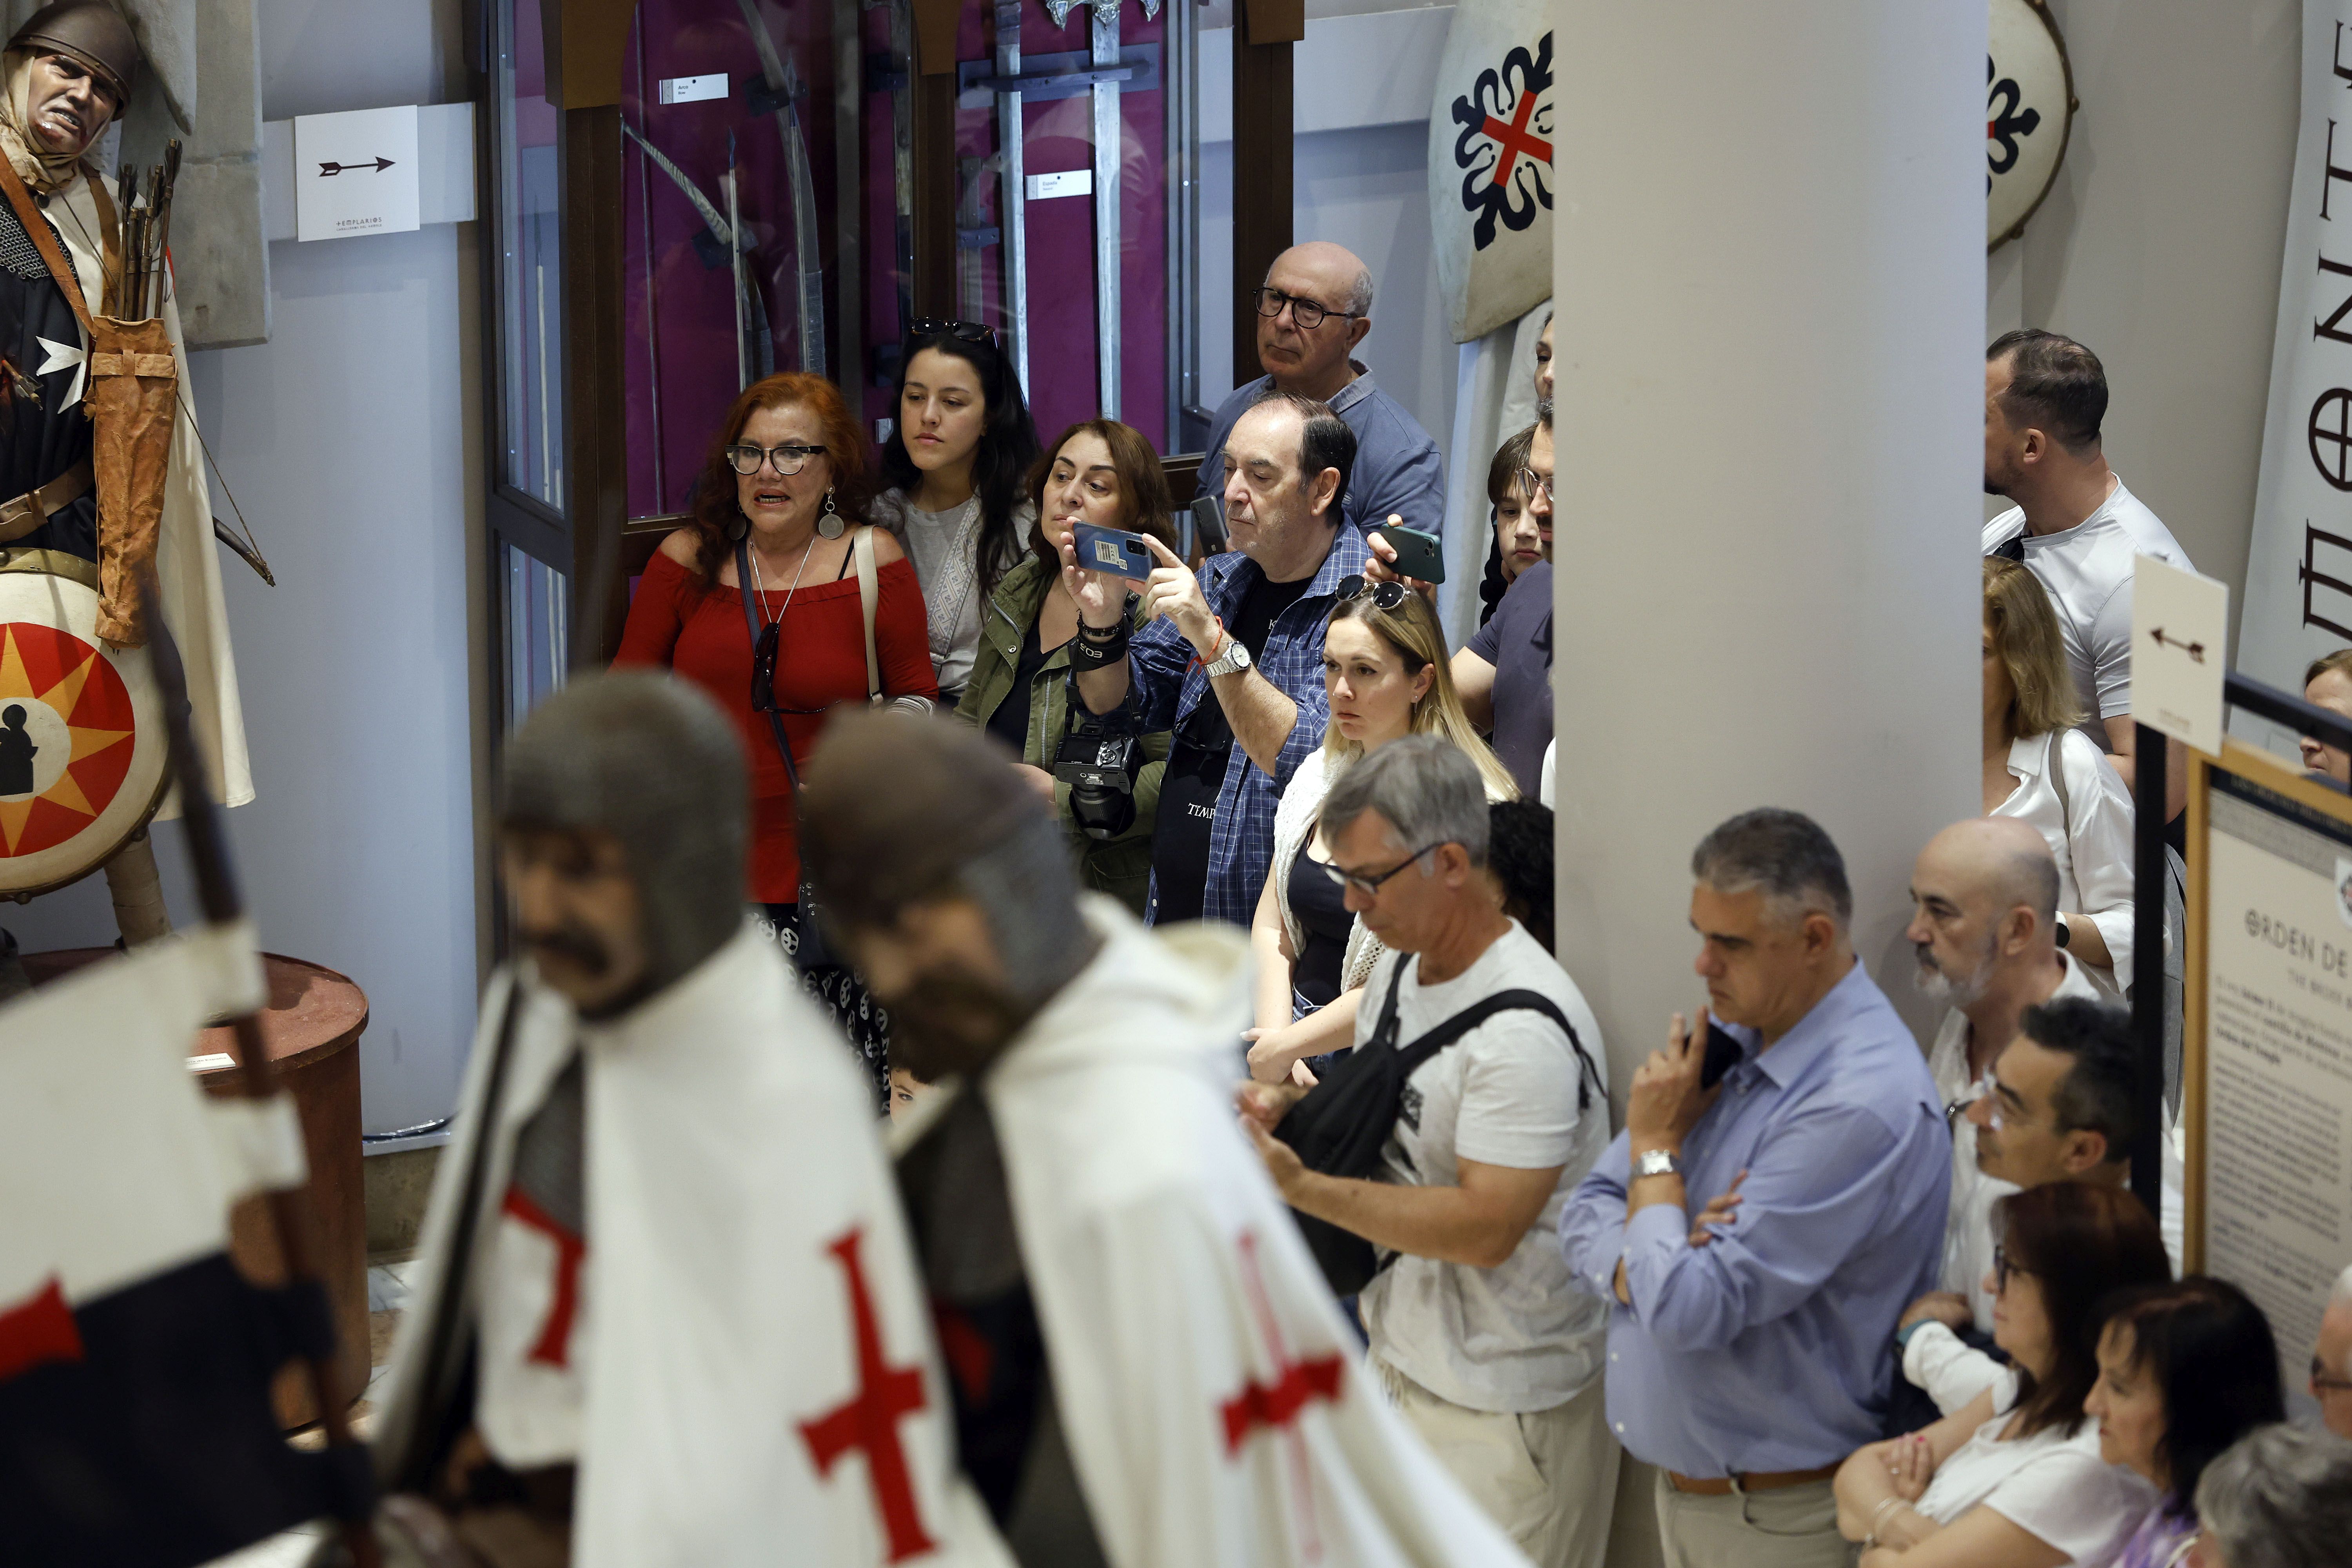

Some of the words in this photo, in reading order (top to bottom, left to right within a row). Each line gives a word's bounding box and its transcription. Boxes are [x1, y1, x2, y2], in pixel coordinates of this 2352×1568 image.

[1080, 643, 1103, 658] EOS
[2244, 908, 2315, 962] ORDEN
[2321, 942, 2348, 979] DE
